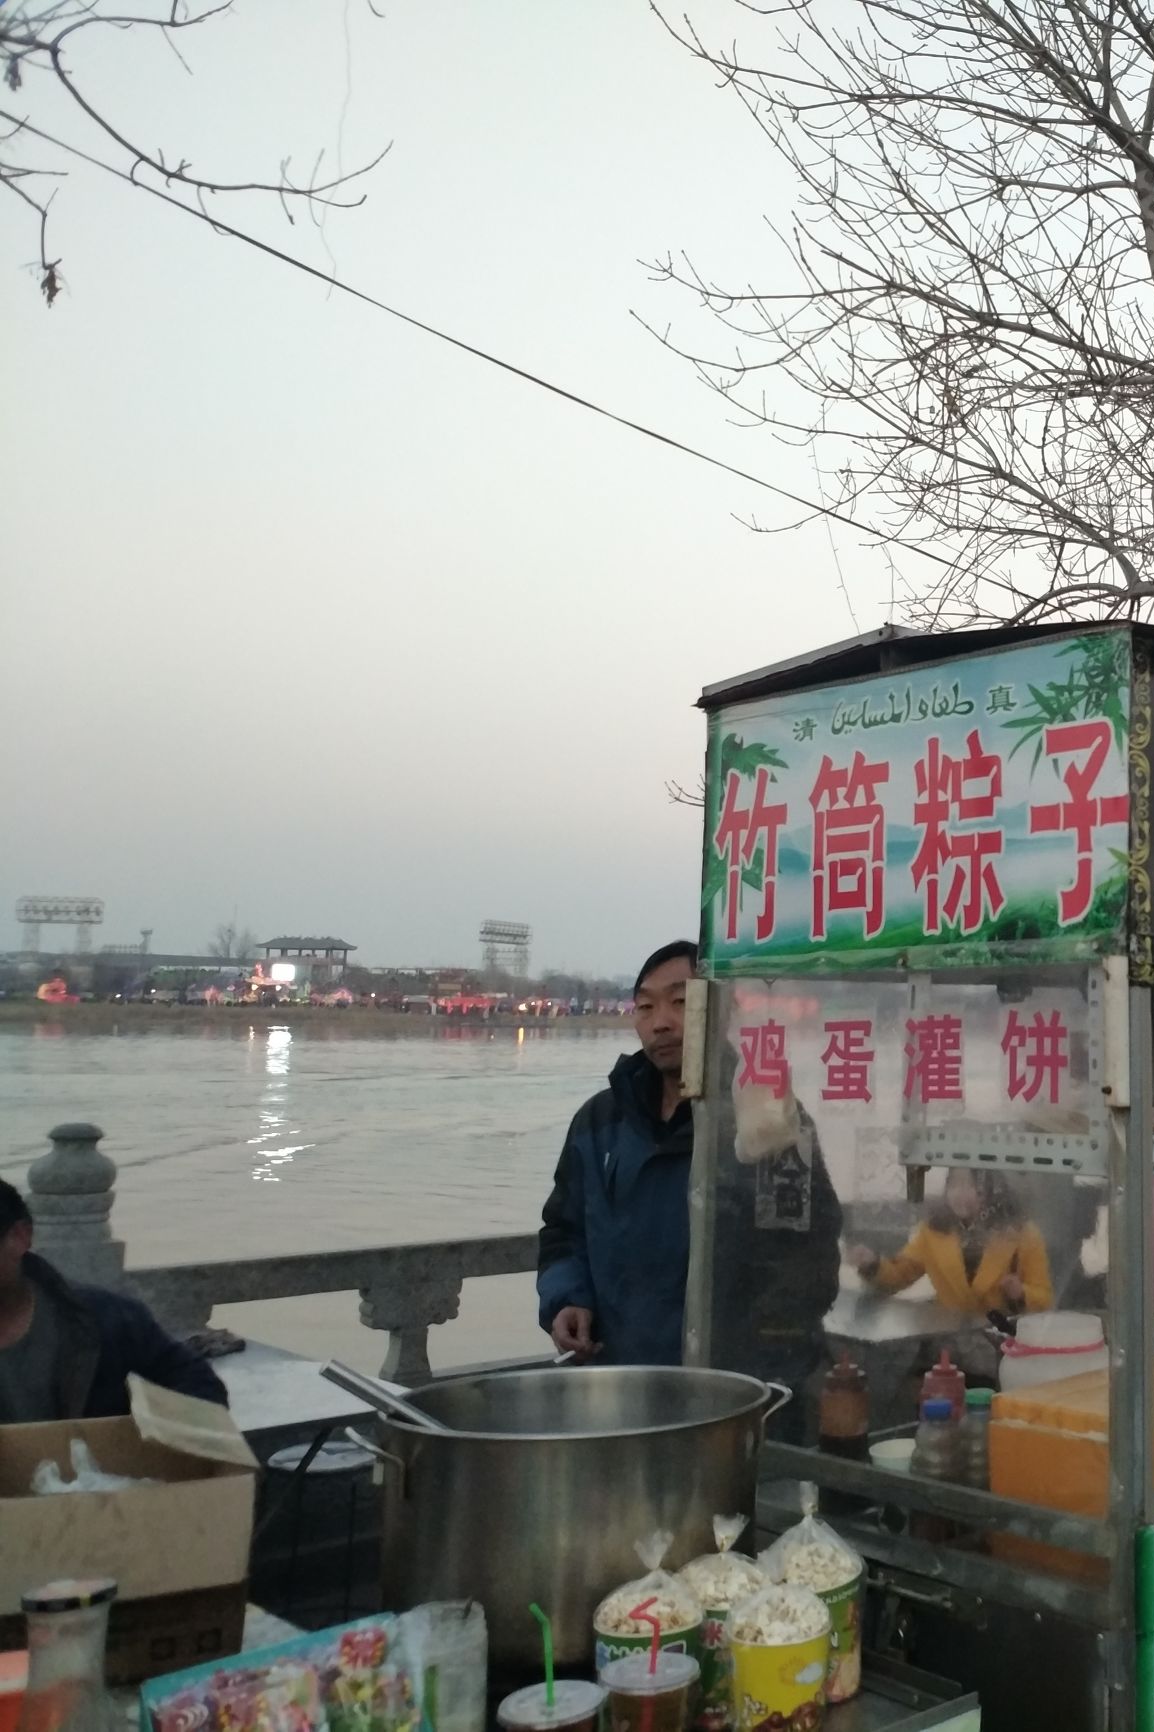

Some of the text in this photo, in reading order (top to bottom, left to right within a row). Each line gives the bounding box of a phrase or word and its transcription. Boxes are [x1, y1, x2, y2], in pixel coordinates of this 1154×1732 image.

[792, 718, 817, 742] 清
[986, 685, 1017, 715] 真
[714, 719, 1129, 942] 竹筒粽子
[738, 1009, 1069, 1105] 鸡蛋灌饼
